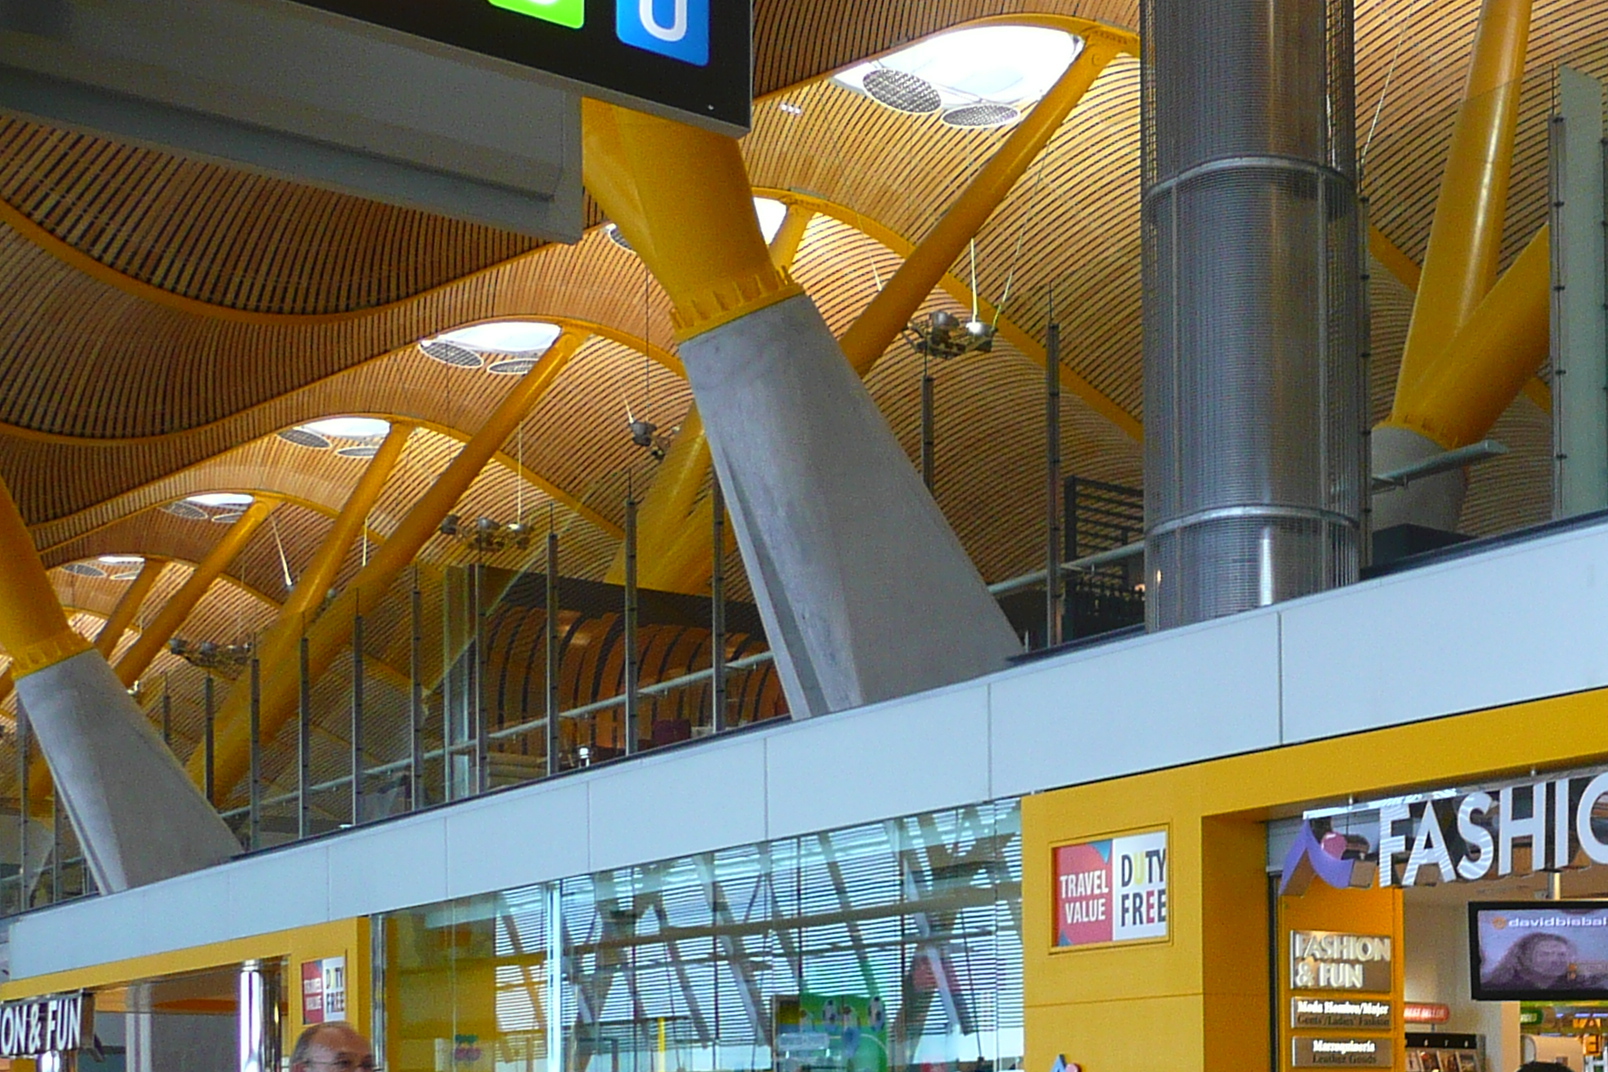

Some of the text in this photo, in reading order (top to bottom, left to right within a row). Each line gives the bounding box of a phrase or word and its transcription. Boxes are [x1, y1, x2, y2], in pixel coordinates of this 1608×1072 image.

[1121, 848, 1166, 888] DUTY
[1060, 869, 1110, 899] TRAVEL
[1065, 898, 1106, 924] VALUE
[1121, 889, 1166, 927] FREE
[1295, 934, 1391, 961] FASHION
[1295, 962, 1363, 988] & FUN
[29, 1003, 41, 1054] &
[46, 996, 81, 1051] FUN
